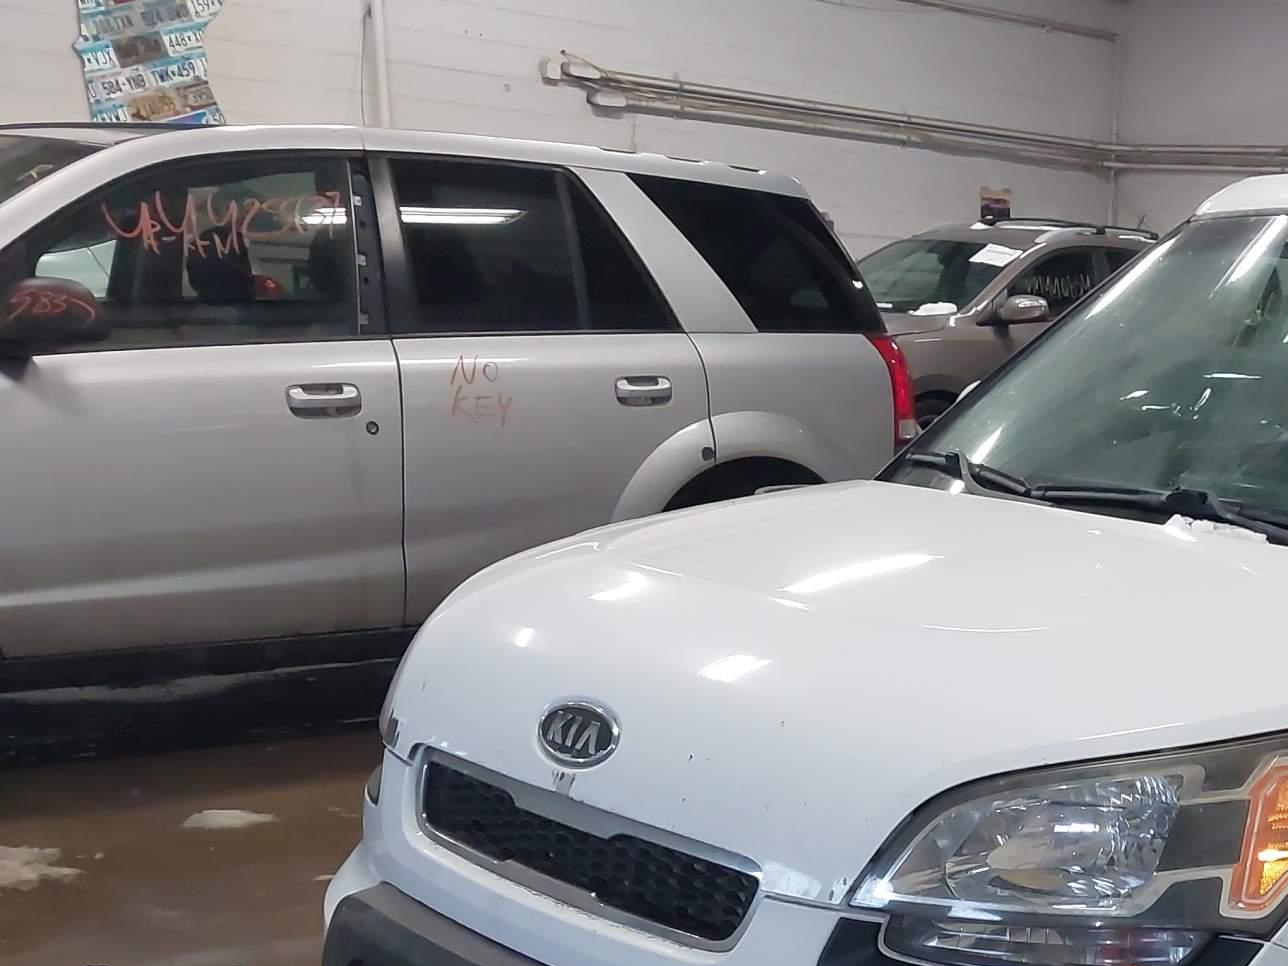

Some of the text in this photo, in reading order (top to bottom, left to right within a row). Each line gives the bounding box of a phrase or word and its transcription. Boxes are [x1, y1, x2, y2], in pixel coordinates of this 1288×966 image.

[450, 353, 499, 386] NO
[451, 384, 513, 429] KEY
[546, 712, 601, 755] KIA
